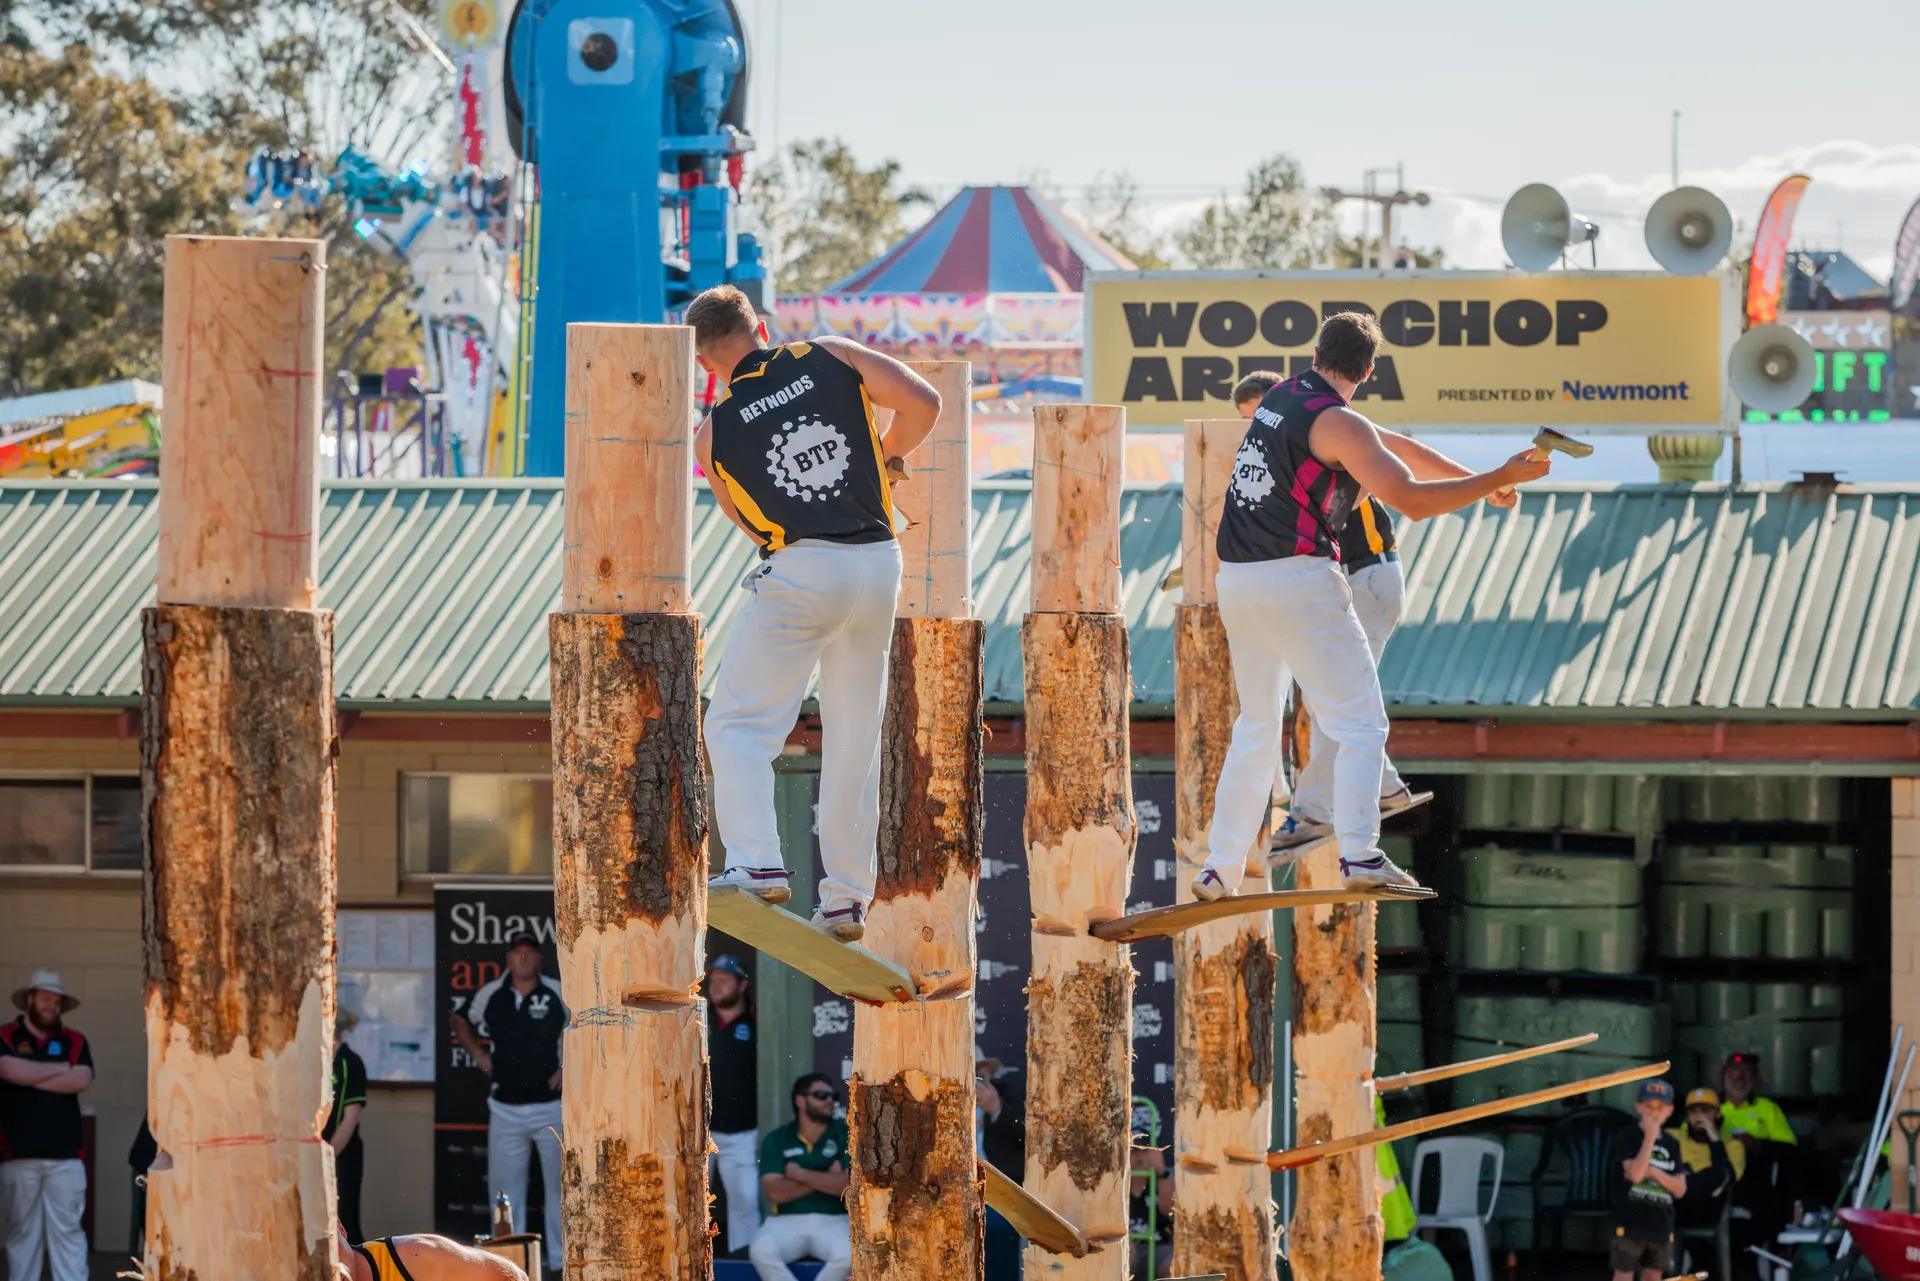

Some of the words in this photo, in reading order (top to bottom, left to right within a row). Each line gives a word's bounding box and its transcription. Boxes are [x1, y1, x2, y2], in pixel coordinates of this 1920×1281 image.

[1122, 355, 1405, 402] ARA
[1437, 388, 1532, 401] PRESENTED
[1535, 388, 1556, 401] BY
[1562, 380, 1689, 401] Newmont
[1811, 352, 1887, 392] IFT
[739, 374, 815, 424] REYNOLDS
[793, 439, 838, 473] BTP
[1239, 463, 1267, 483] BTP
[450, 901, 557, 944] Shaw
[450, 961, 502, 990] an
